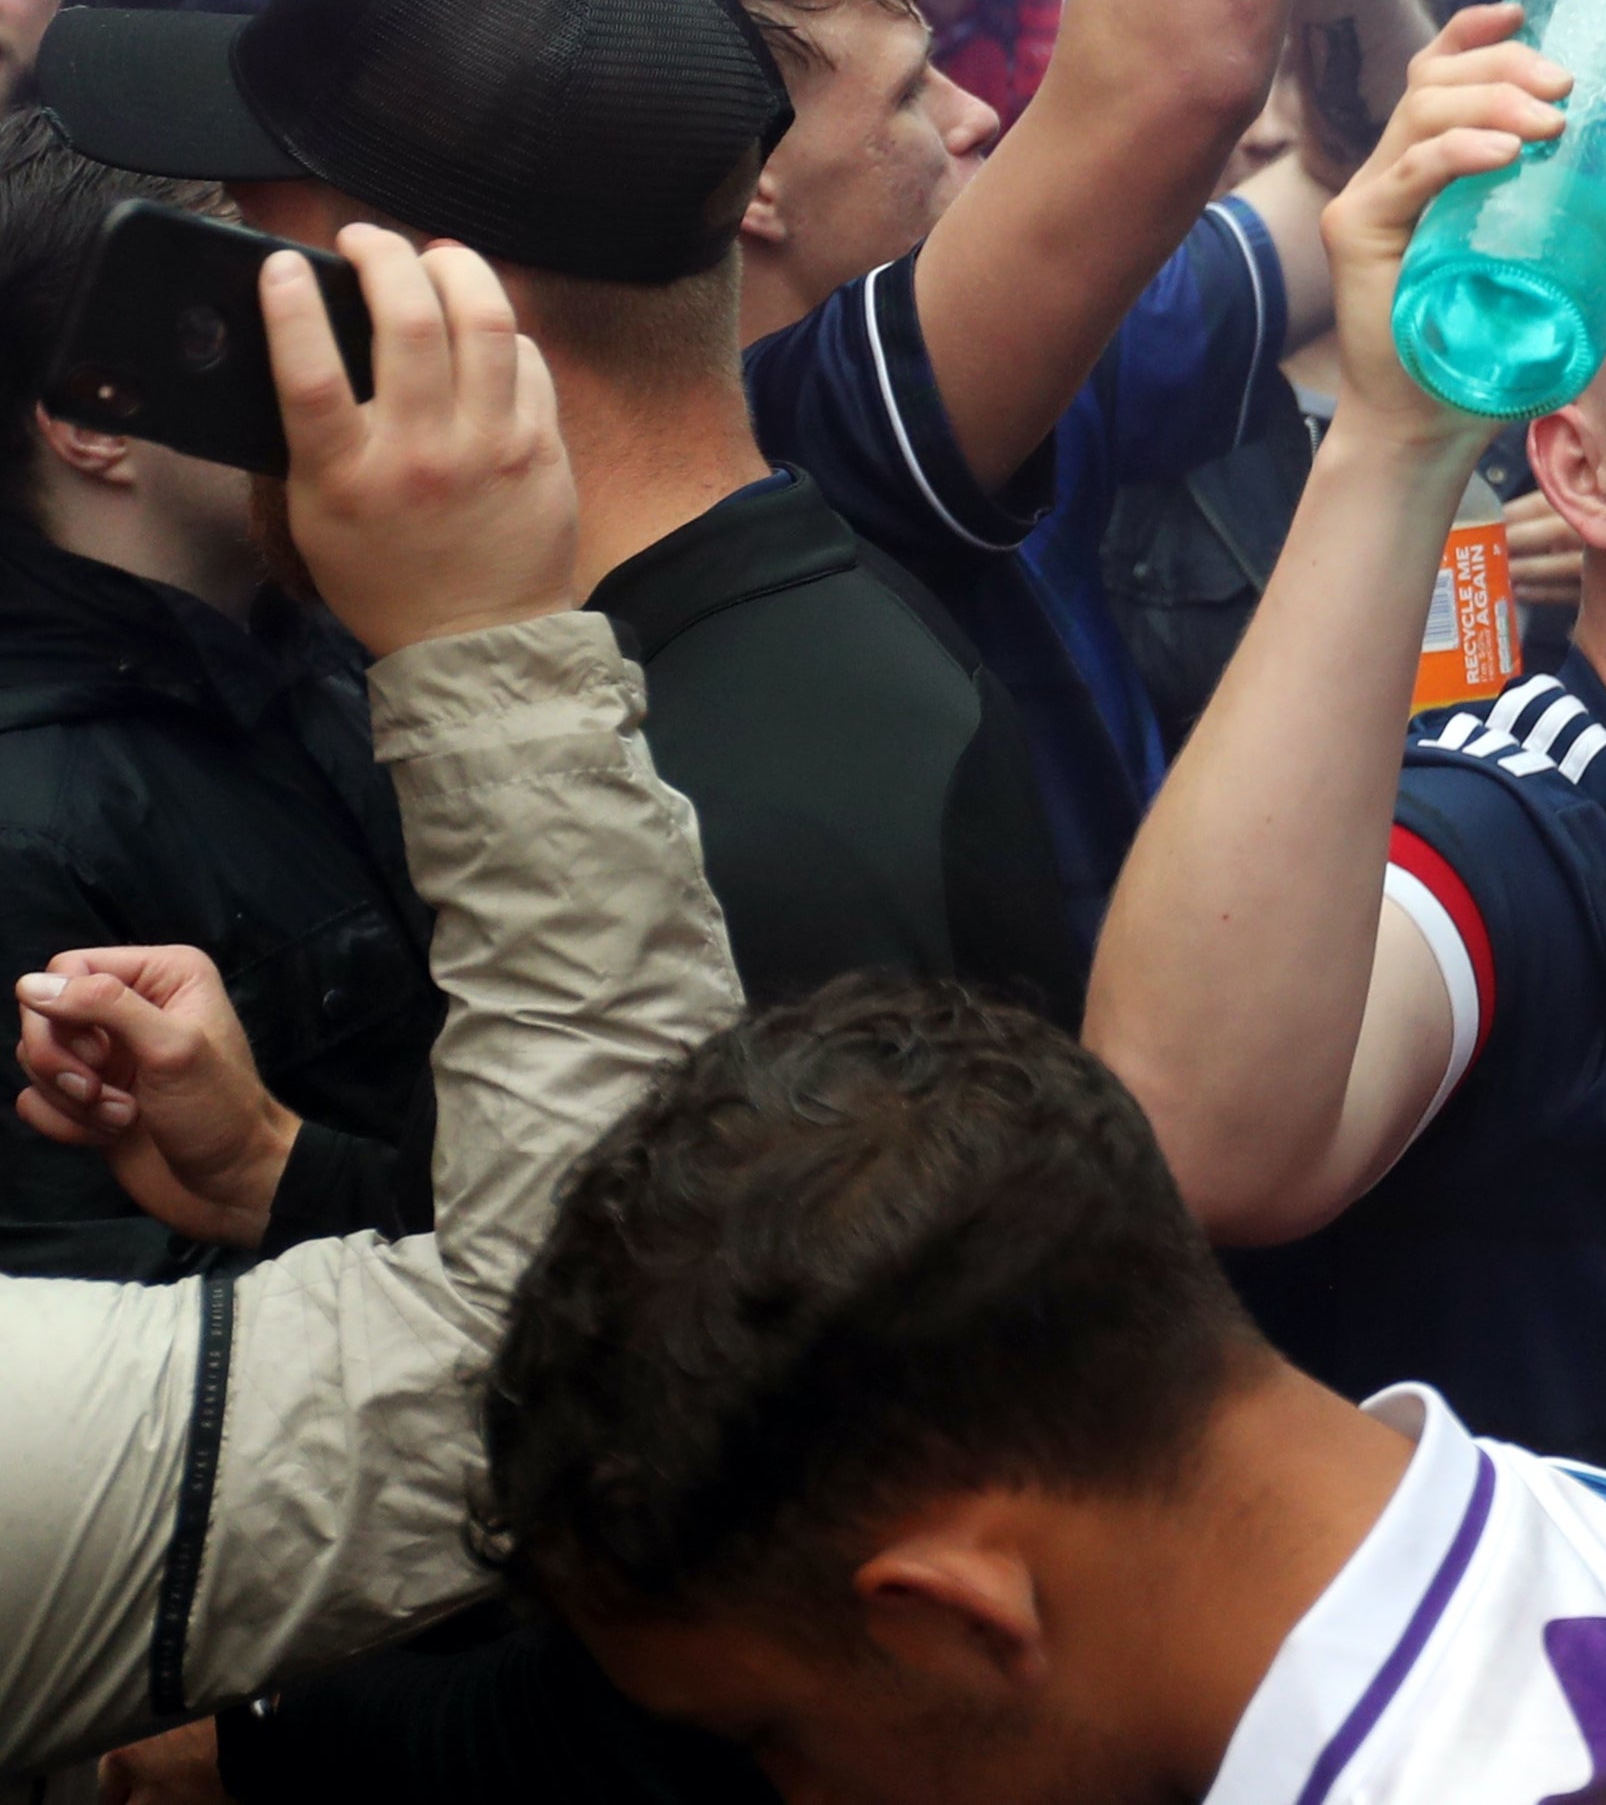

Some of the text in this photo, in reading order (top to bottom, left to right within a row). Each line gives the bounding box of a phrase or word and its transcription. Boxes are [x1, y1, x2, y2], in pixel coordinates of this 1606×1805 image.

[1456, 545, 1481, 685] RECYCLE ME
[1470, 543, 1491, 626] AGAIN
[193, 1450, 208, 1492] NIKE
[201, 1350, 222, 1428] RUNNING
